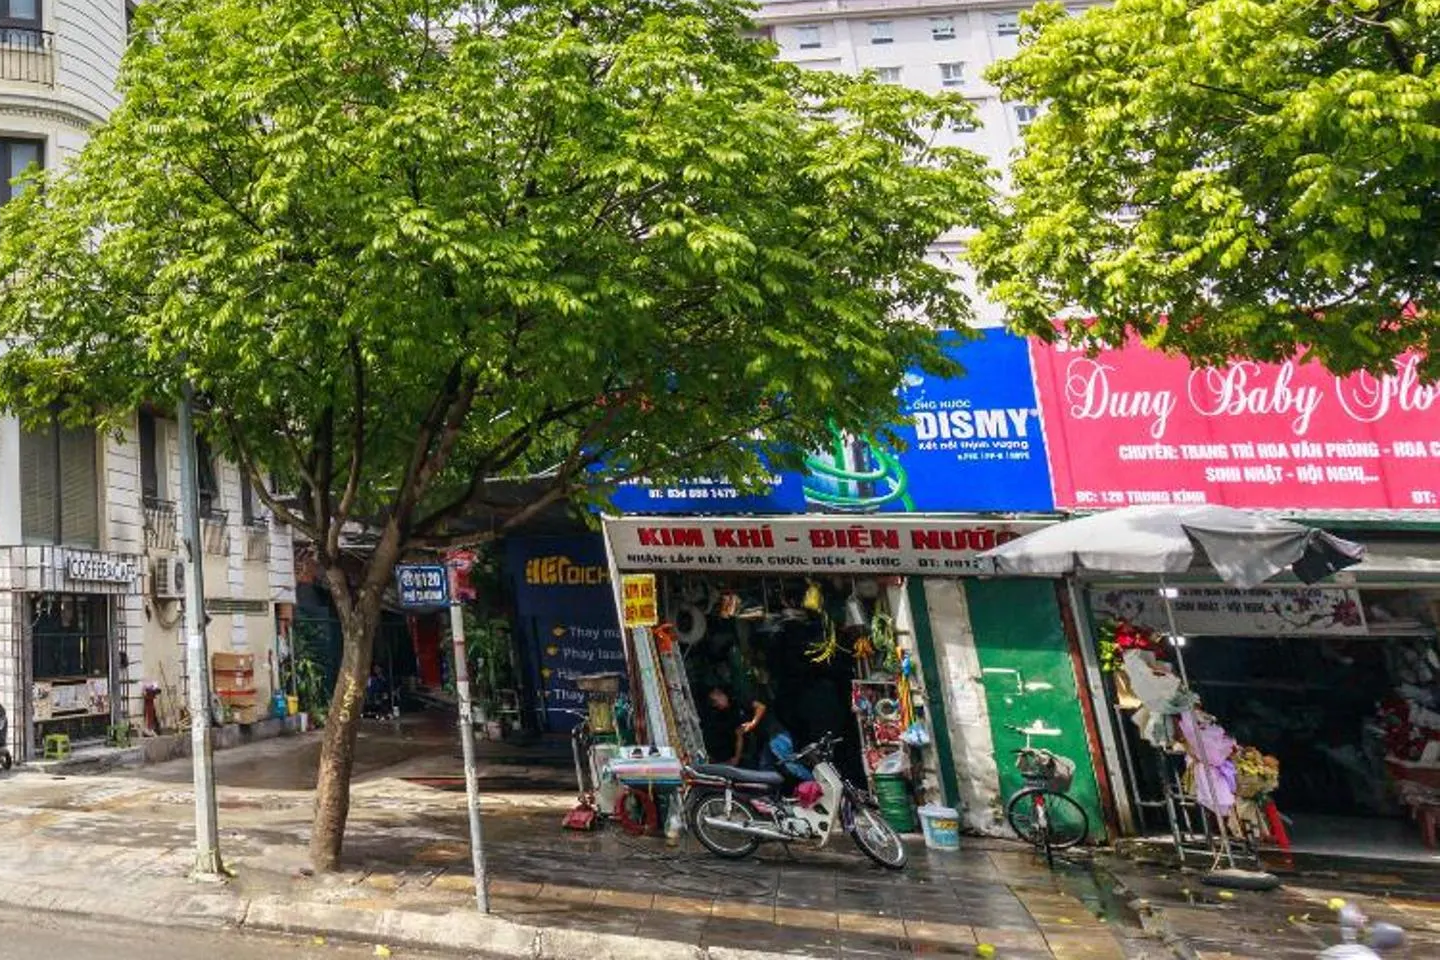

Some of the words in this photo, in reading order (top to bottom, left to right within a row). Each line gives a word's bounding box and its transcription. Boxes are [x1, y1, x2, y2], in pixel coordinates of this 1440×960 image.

[1065, 357, 1178, 439] Dung
[1188, 360, 1323, 436] Baby
[914, 408, 1029, 440] DISMY
[637, 527, 705, 548] KIM
[713, 524, 775, 549] KHÍ
[808, 525, 900, 553] ĐIỆN
